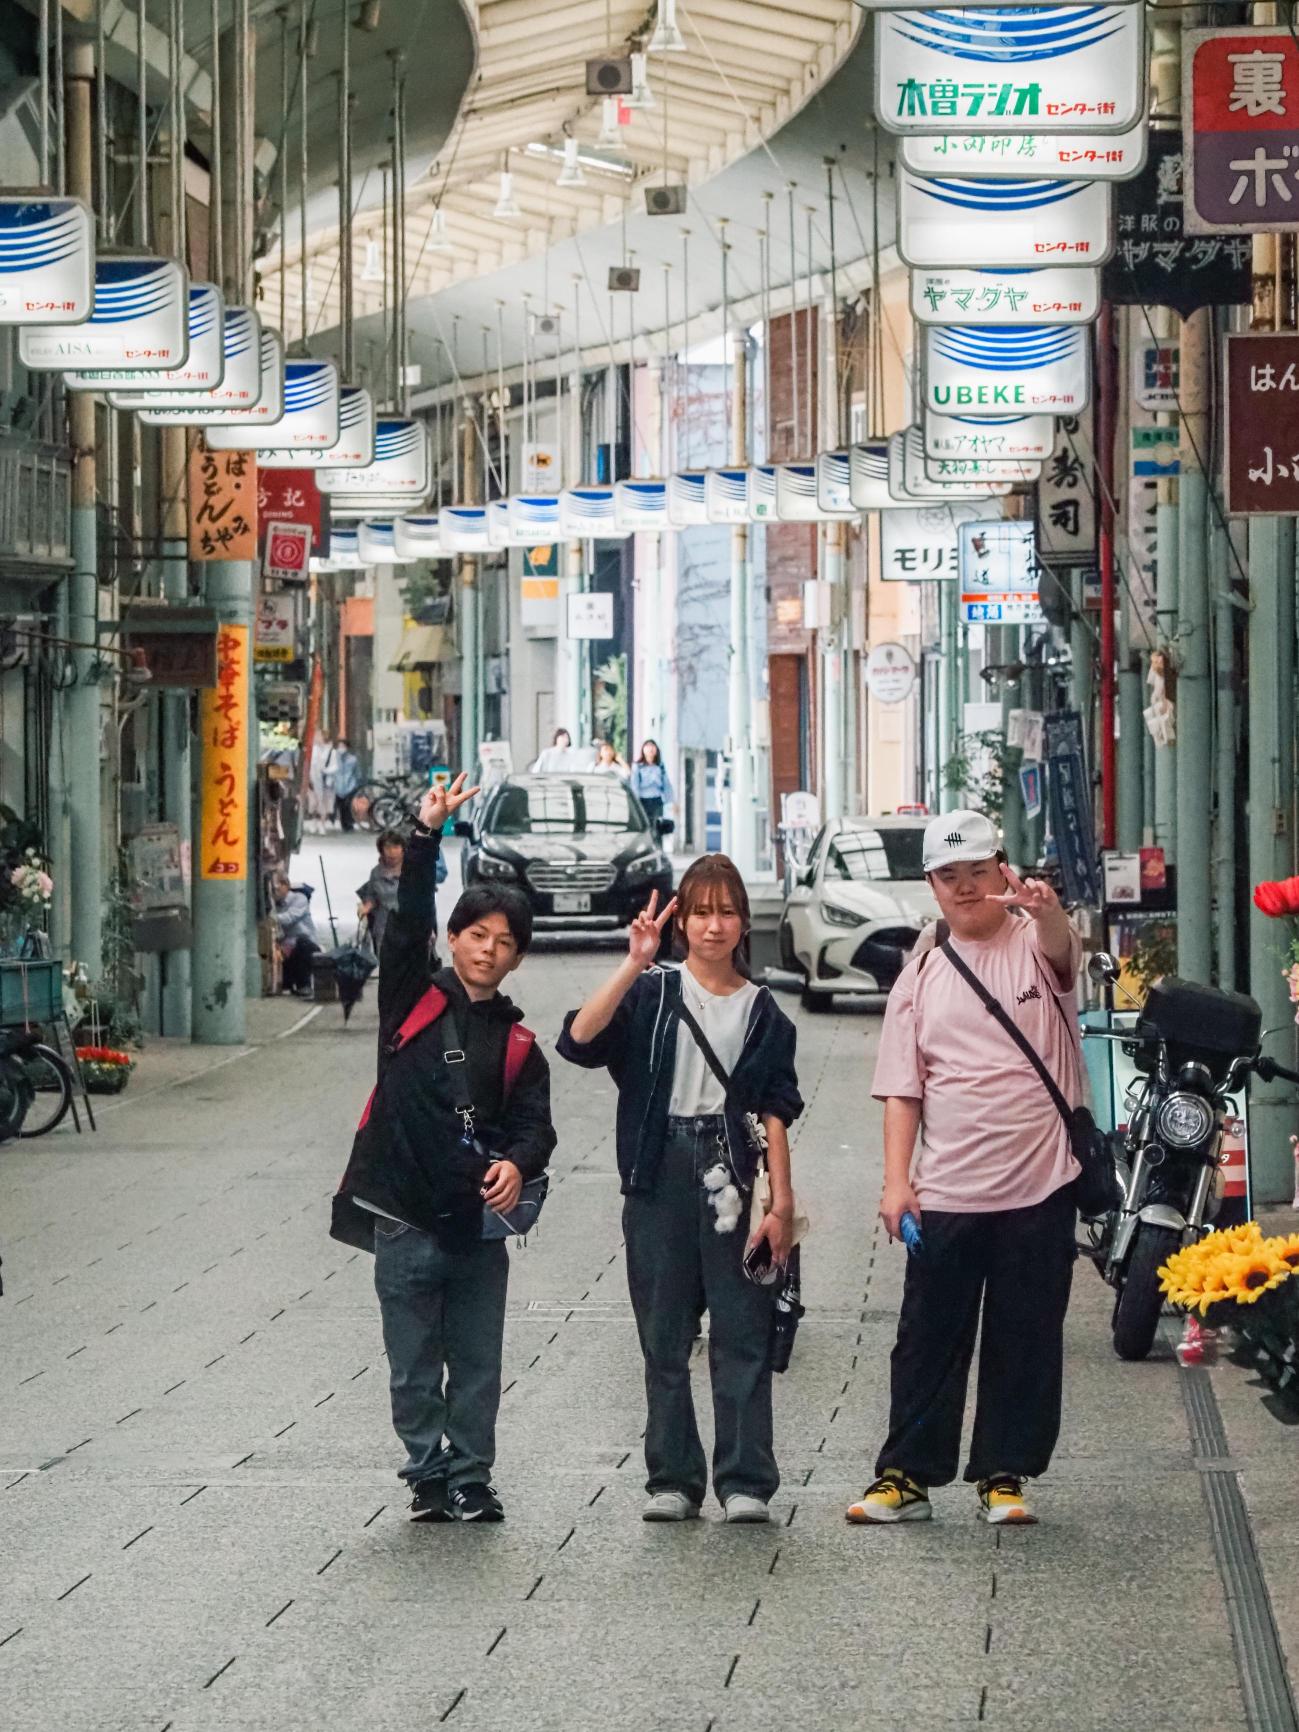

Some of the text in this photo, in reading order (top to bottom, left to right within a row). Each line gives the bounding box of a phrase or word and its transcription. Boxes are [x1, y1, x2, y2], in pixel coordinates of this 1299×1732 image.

[1228, 50, 1287, 117] 裏
[1046, 102, 1116, 116] センター街
[1058, 150, 1123, 163] センター街
[1229, 145, 1299, 208] ボ
[1119, 214, 1180, 233] 洋服の
[1034, 241, 1090, 253] センター街
[24, 301, 76, 312] センター街
[1032, 302, 1082, 313] センター街
[124, 349, 170, 359] センター街
[934, 384, 1026, 406] UBEKE
[1249, 446, 1299, 485] 小
